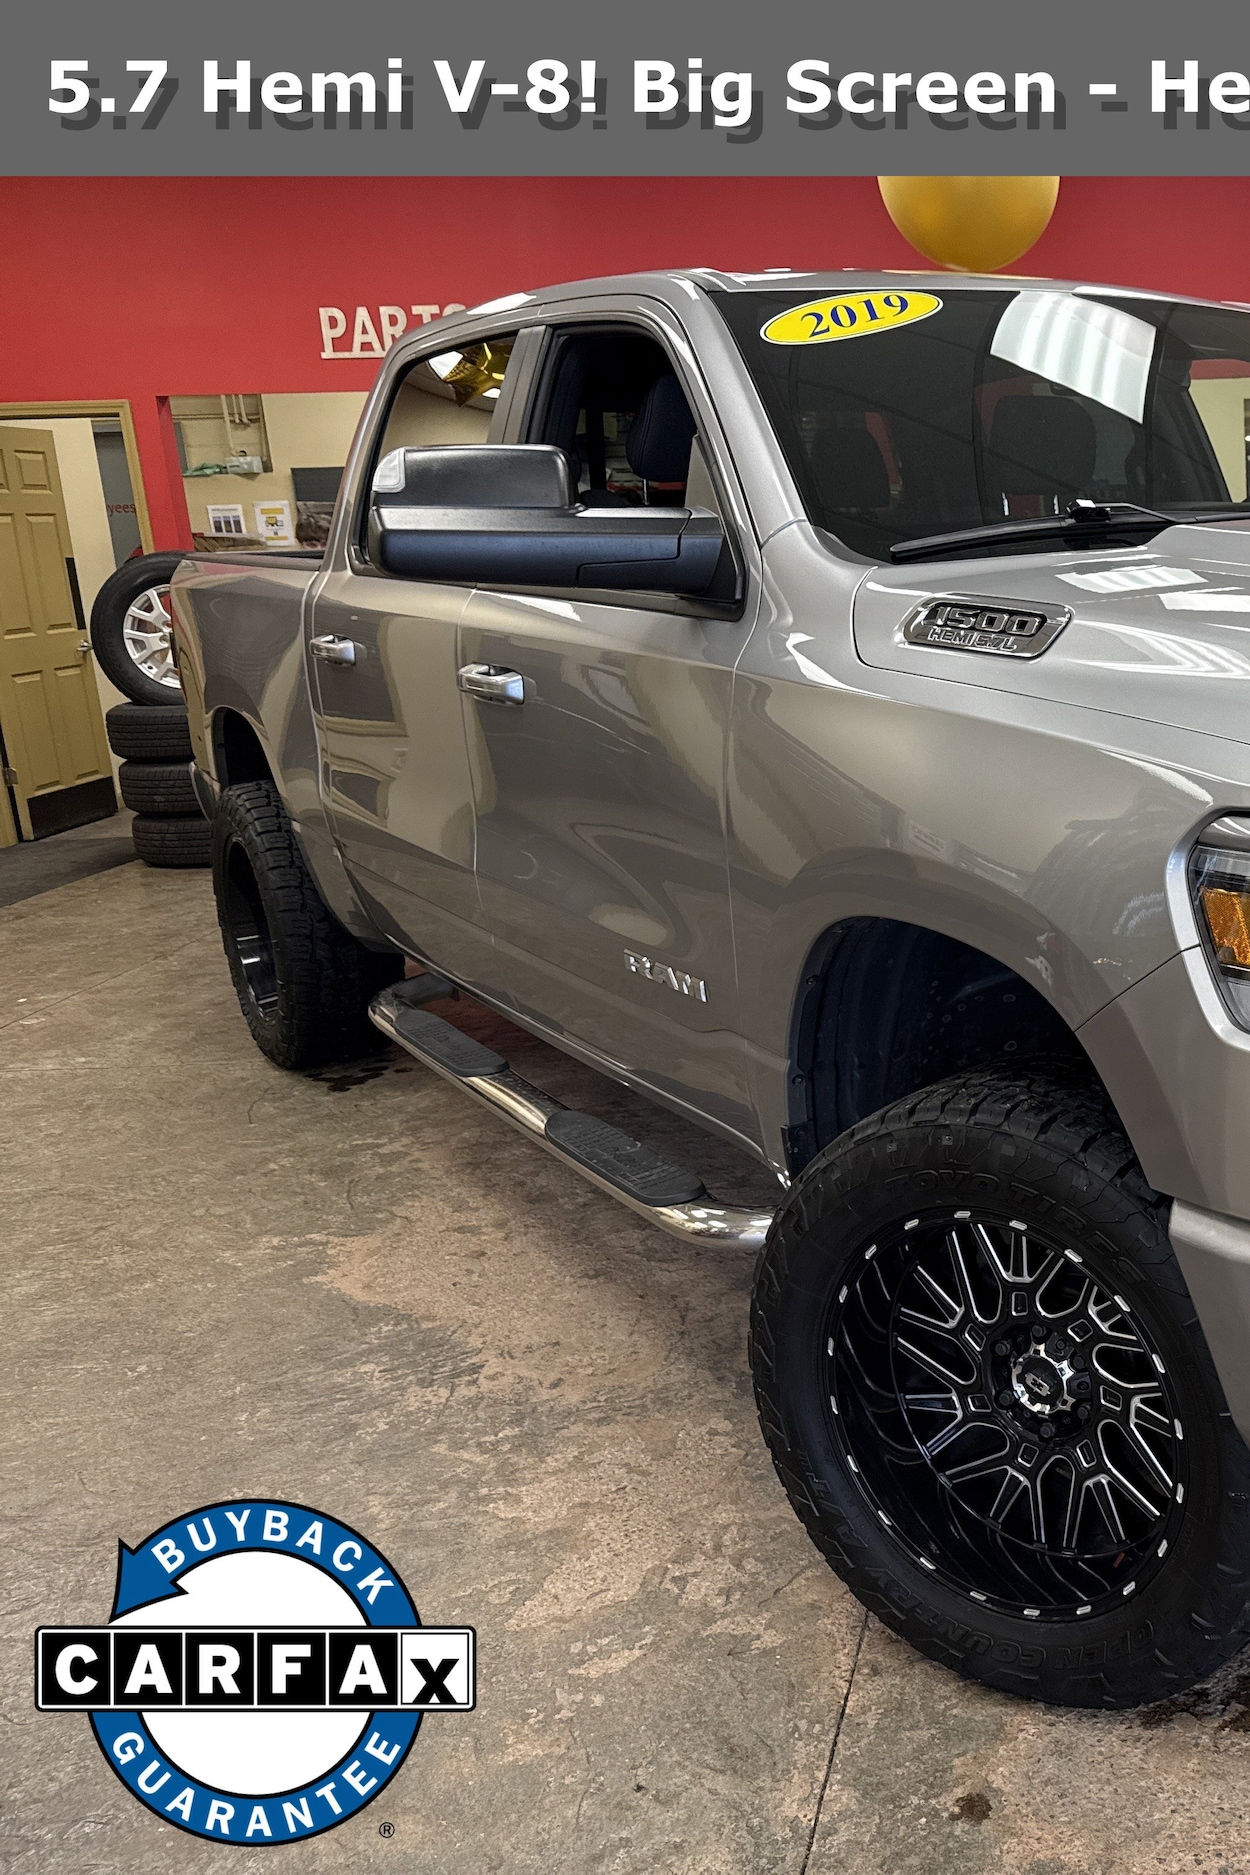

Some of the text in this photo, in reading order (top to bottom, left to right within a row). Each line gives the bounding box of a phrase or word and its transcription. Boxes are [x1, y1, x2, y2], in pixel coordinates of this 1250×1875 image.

[318, 303, 466, 353] PART
[800, 294, 909, 338] 2019
[927, 627, 1018, 652] HEMI 5.7L
[932, 605, 1042, 636] 1500
[884, 1169, 1147, 1286] TOYO TIRES
[864, 1566, 1048, 1669] COUNTRY
[1054, 1619, 1155, 1670] OPEN
